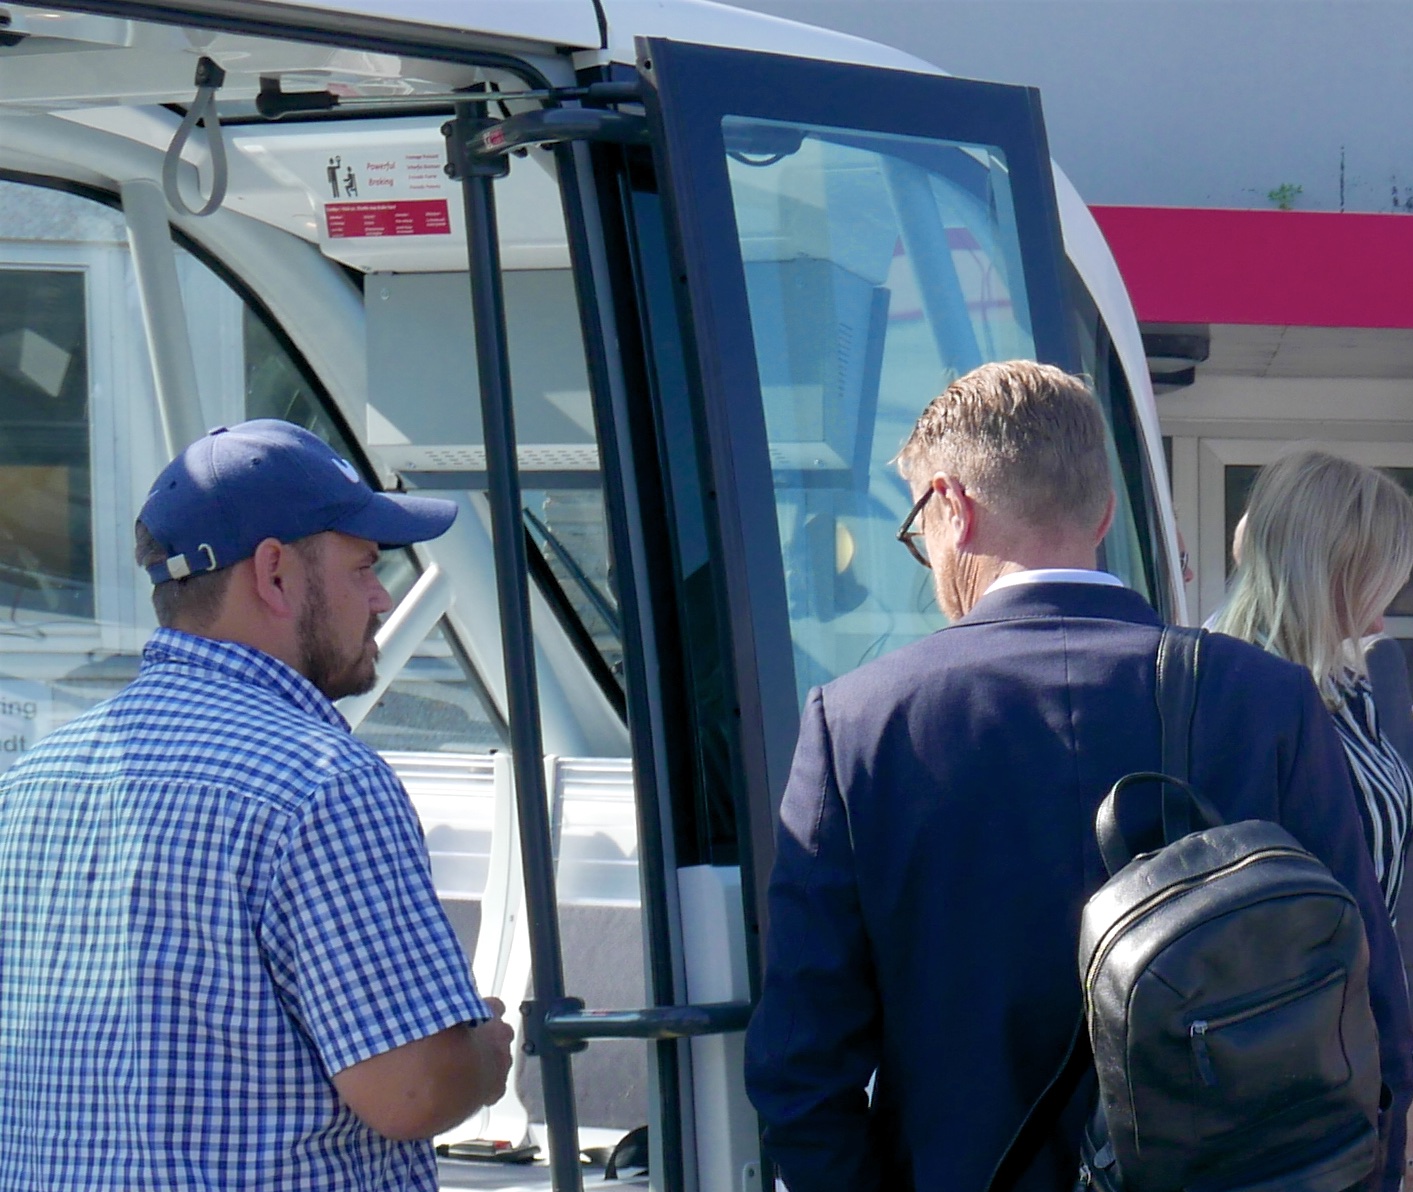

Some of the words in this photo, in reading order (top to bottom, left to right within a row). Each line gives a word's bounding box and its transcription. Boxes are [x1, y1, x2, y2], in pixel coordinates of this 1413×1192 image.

[366, 161, 396, 171] Powerful
[0, 697, 37, 720] ing
[0, 735, 26, 752] dt
